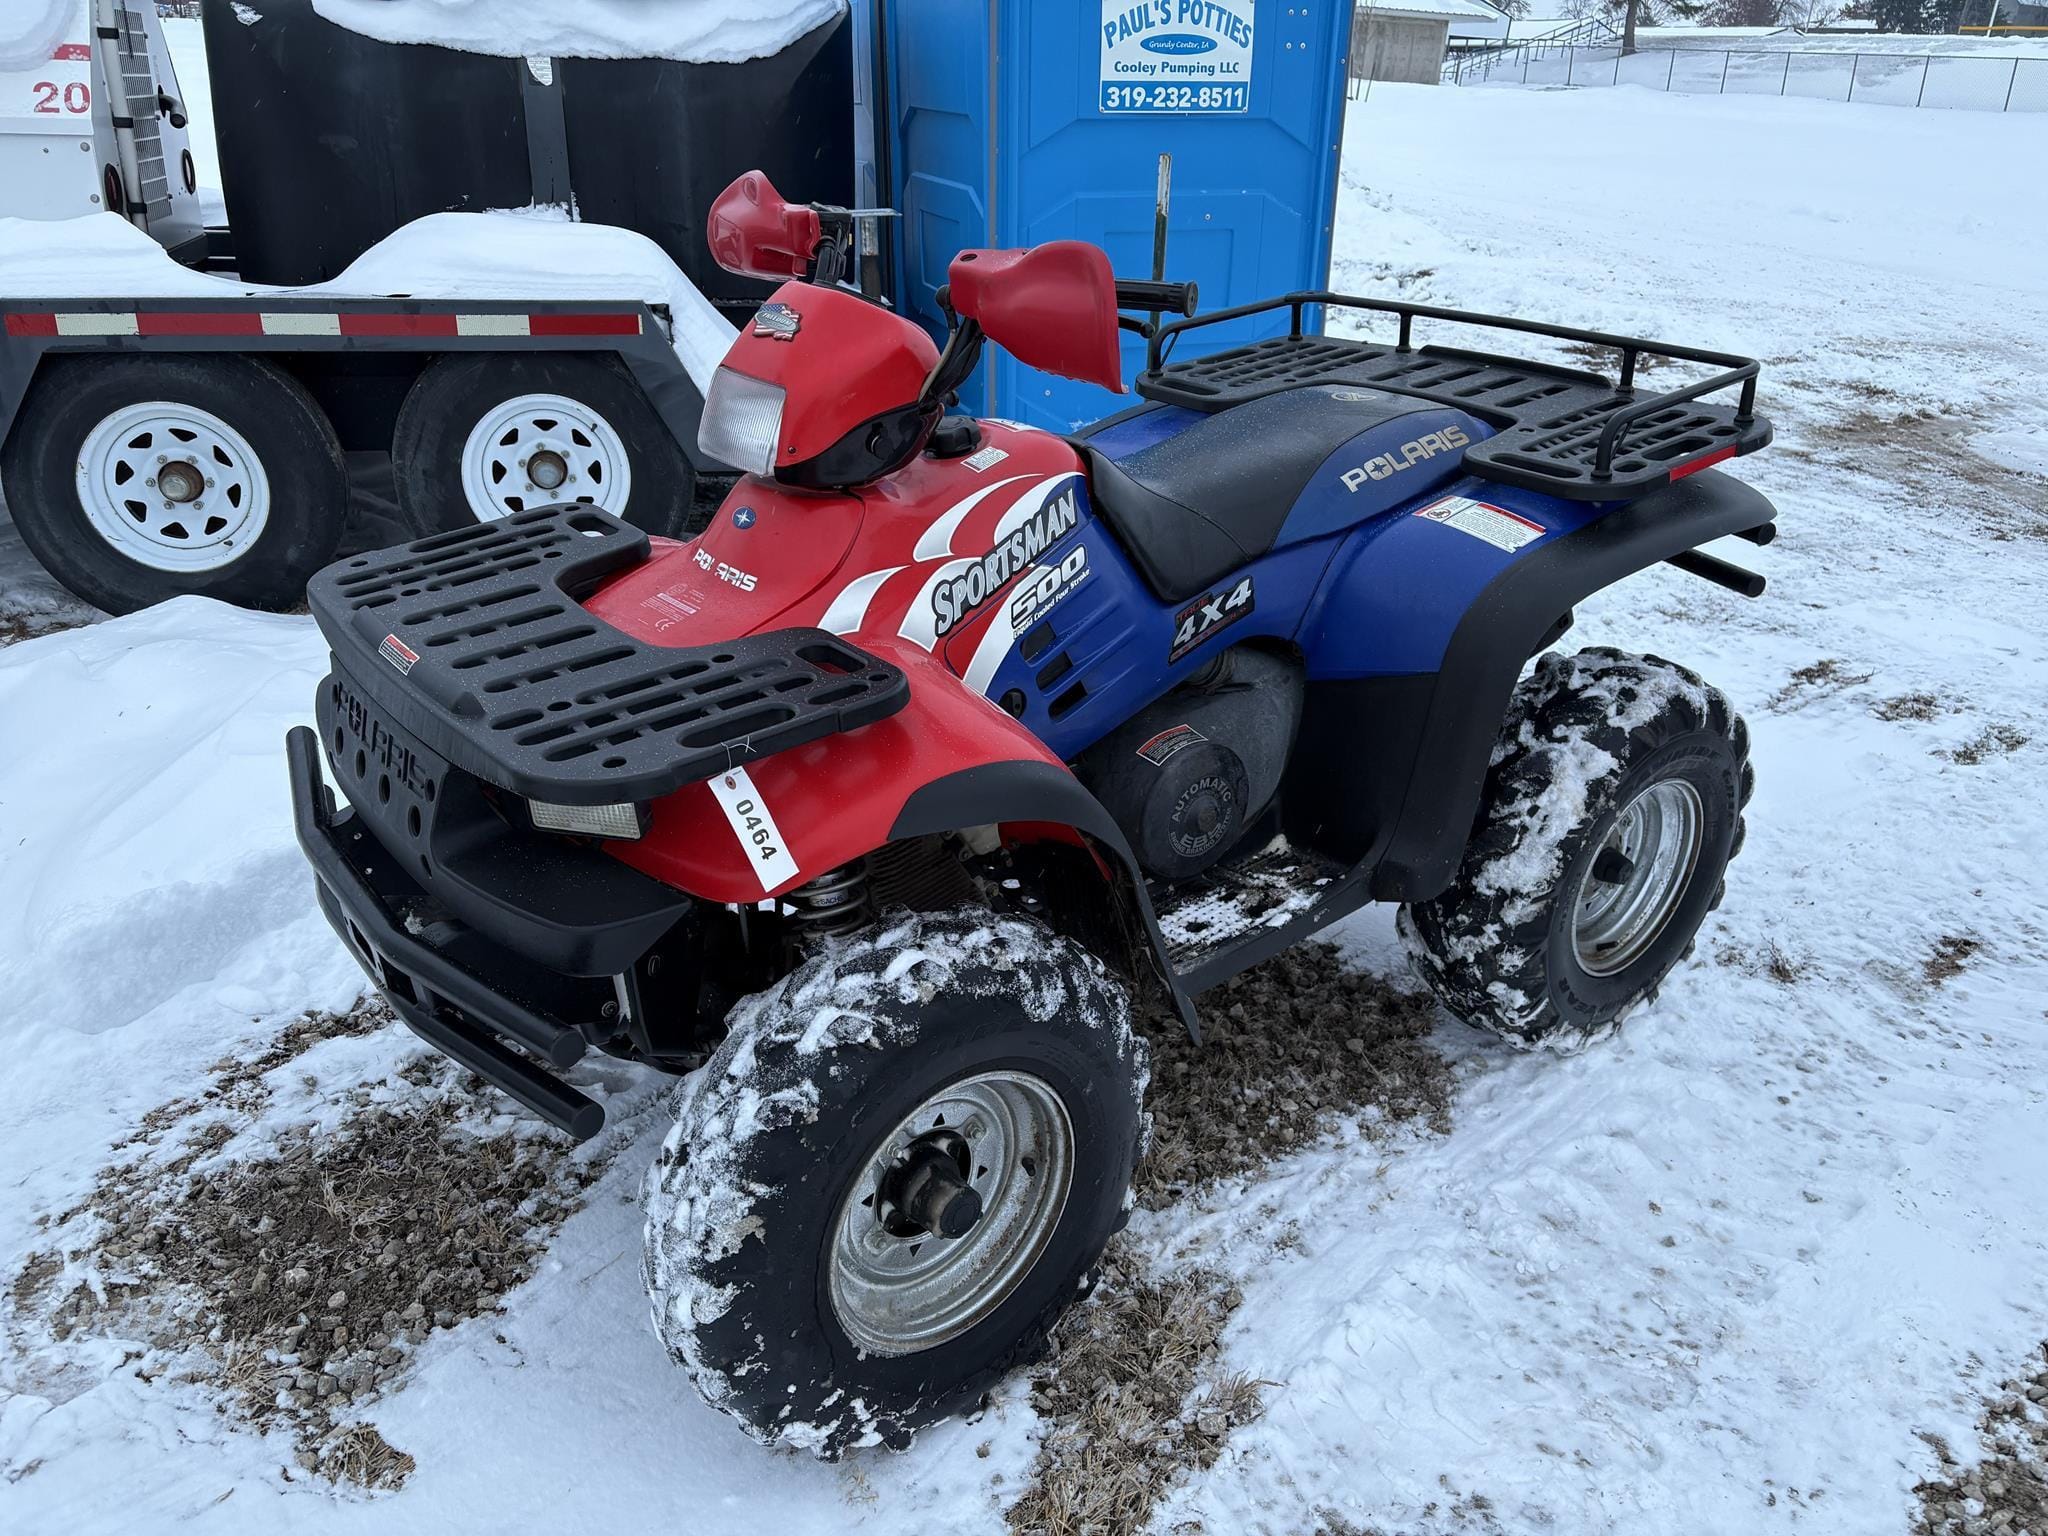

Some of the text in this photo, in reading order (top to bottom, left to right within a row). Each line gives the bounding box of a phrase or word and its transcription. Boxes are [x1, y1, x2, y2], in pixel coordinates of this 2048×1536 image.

[1103, 0, 1252, 49] PAUL'S POTTIES
[1148, 40, 1175, 50] Grundy
[1114, 60, 1240, 77] Cooley Pumping LLC
[32, 81, 91, 114] 20
[1106, 86, 1244, 109] 319-232-8511
[1339, 424, 1471, 494] POLARIS
[934, 488, 1078, 636] SPORTSMAN
[1011, 545, 1087, 628] 500
[1173, 578, 1252, 647] 4X4
[1171, 777, 1232, 822] AUTOMATIC
[736, 799, 778, 861] 0464
